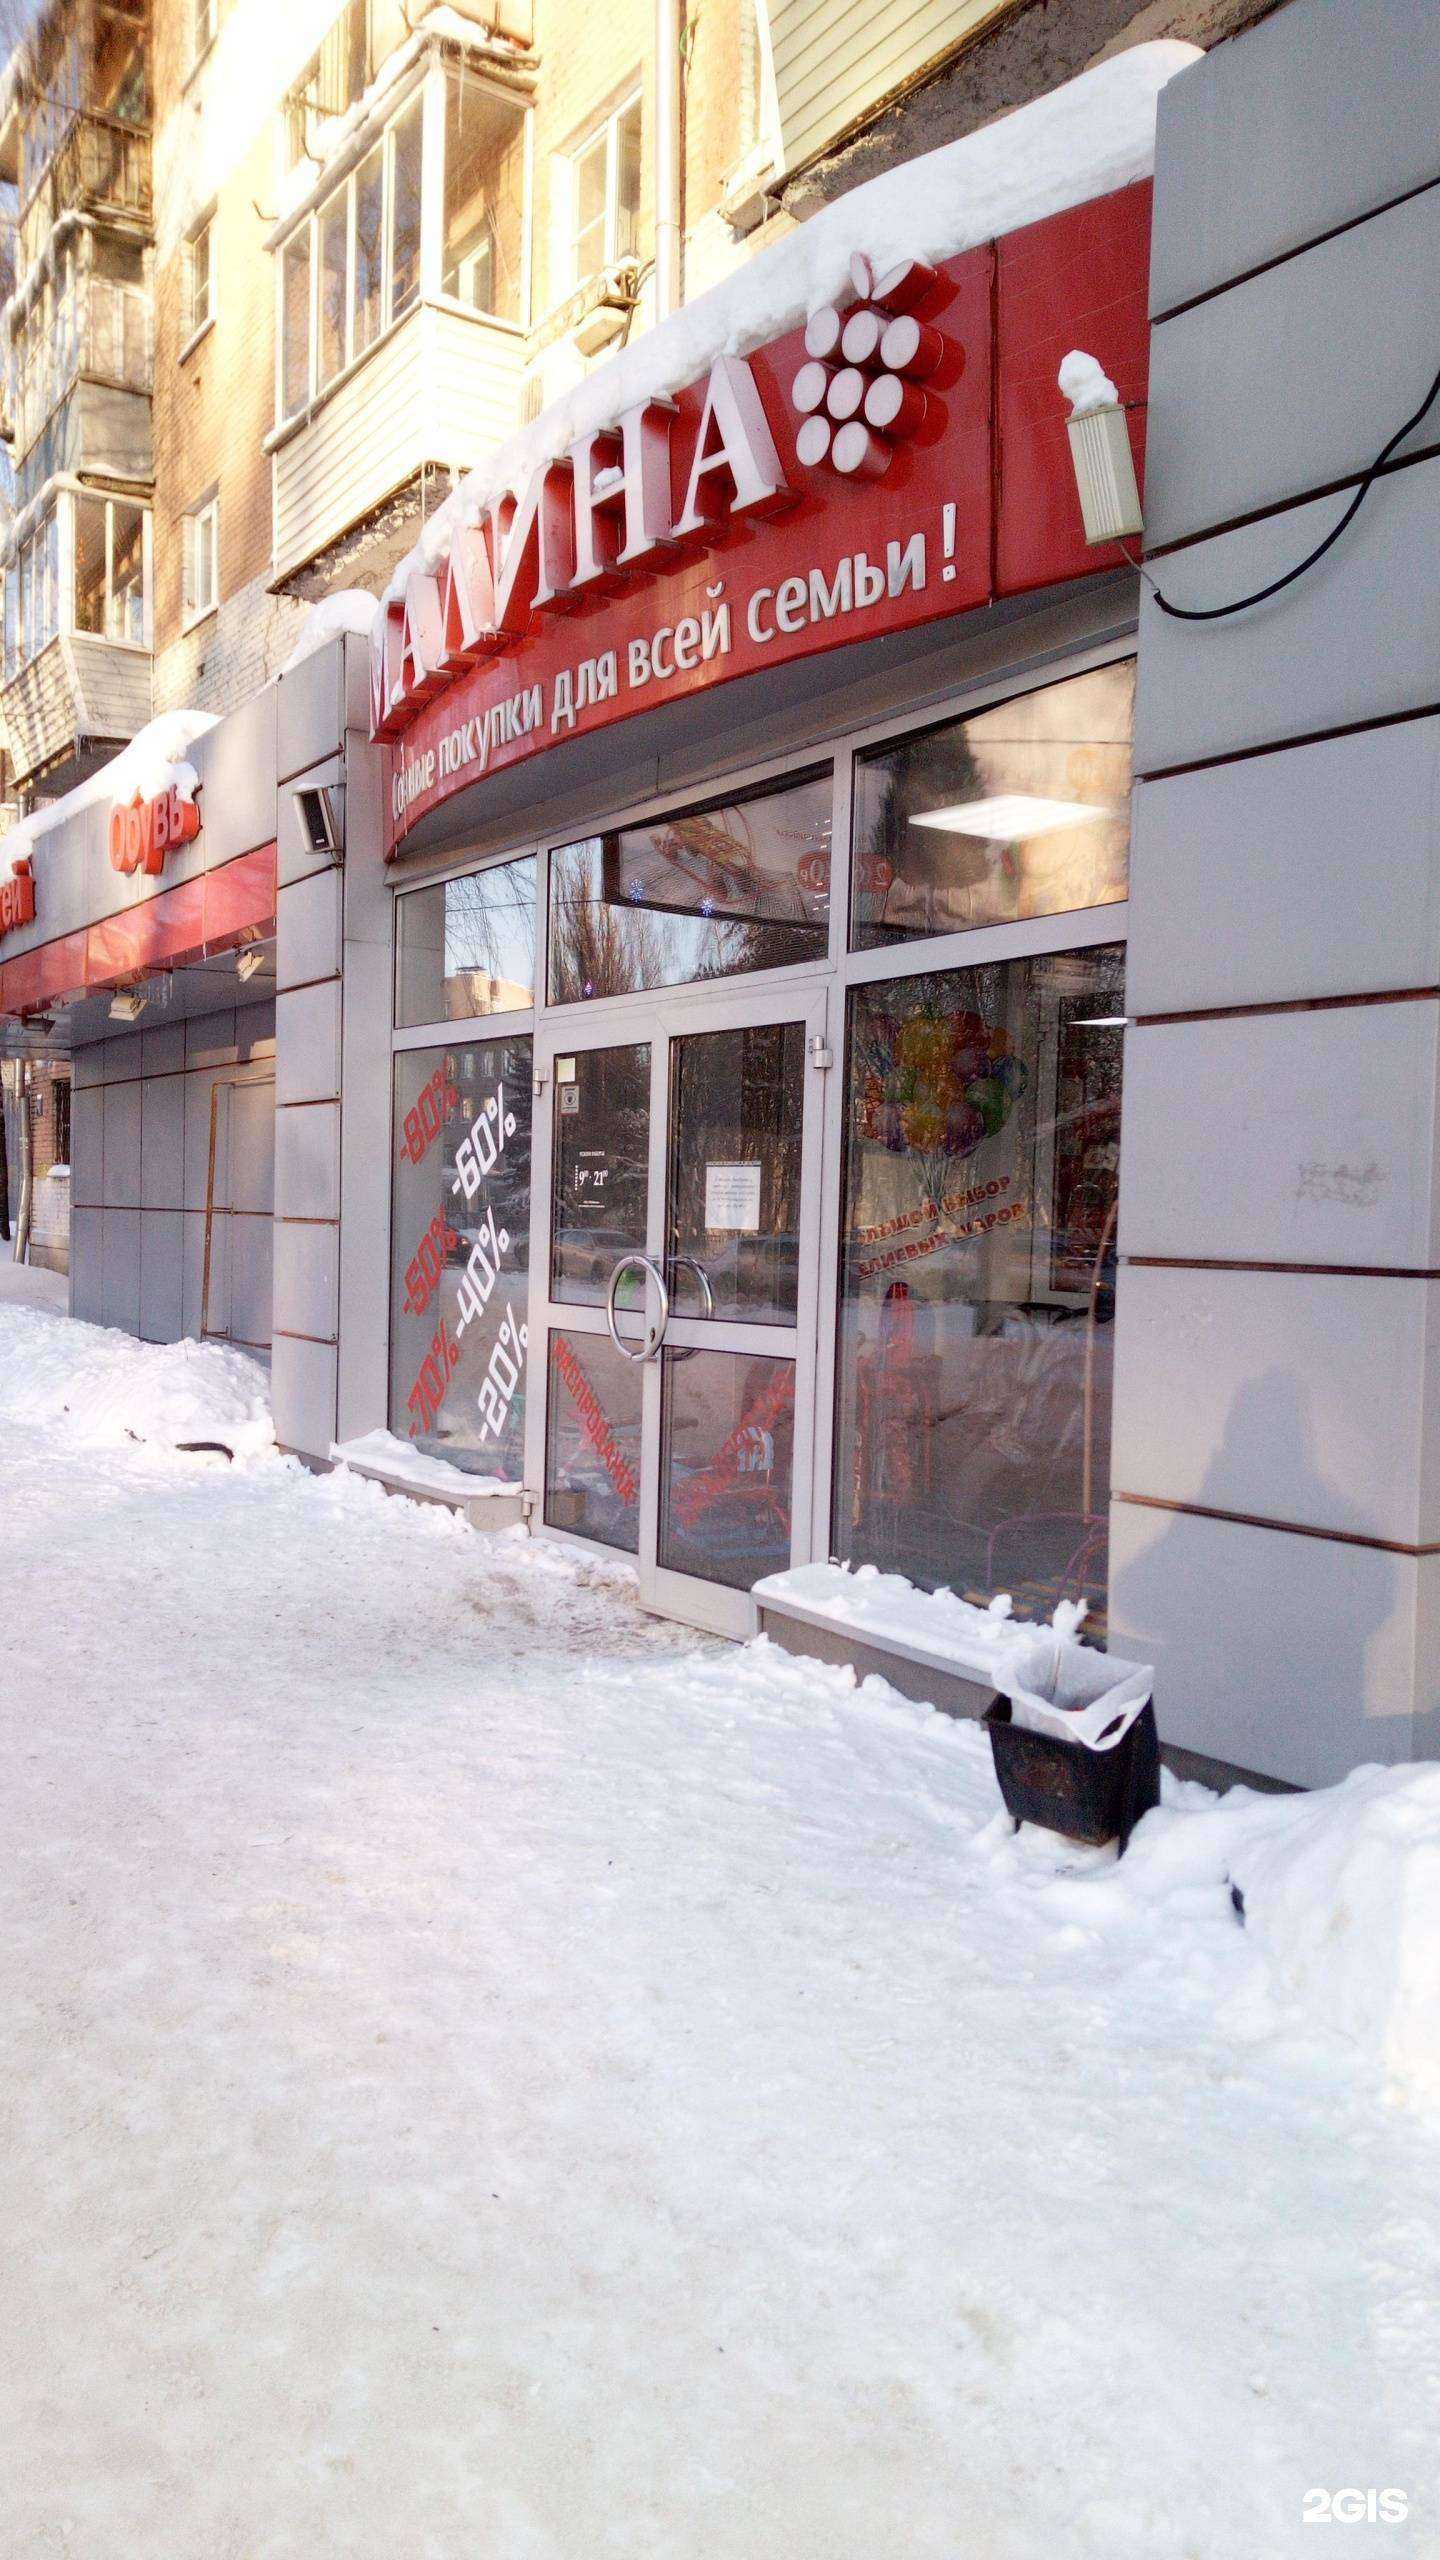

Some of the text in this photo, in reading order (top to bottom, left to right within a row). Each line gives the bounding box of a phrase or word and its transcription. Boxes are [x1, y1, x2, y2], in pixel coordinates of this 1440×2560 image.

[369, 356, 789, 743] МАЛИНА
[438, 684, 543, 771] покупки
[551, 649, 617, 735] для
[628, 580, 731, 689] всей
[400, 1052, 459, 1165] -80%
[452, 1081, 516, 1199] -60%
[402, 1201, 458, 1316] -50%
[456, 1205, 510, 1339] -40%
[408, 1318, 459, 1439] -70%
[479, 1302, 528, 1442] -20%
